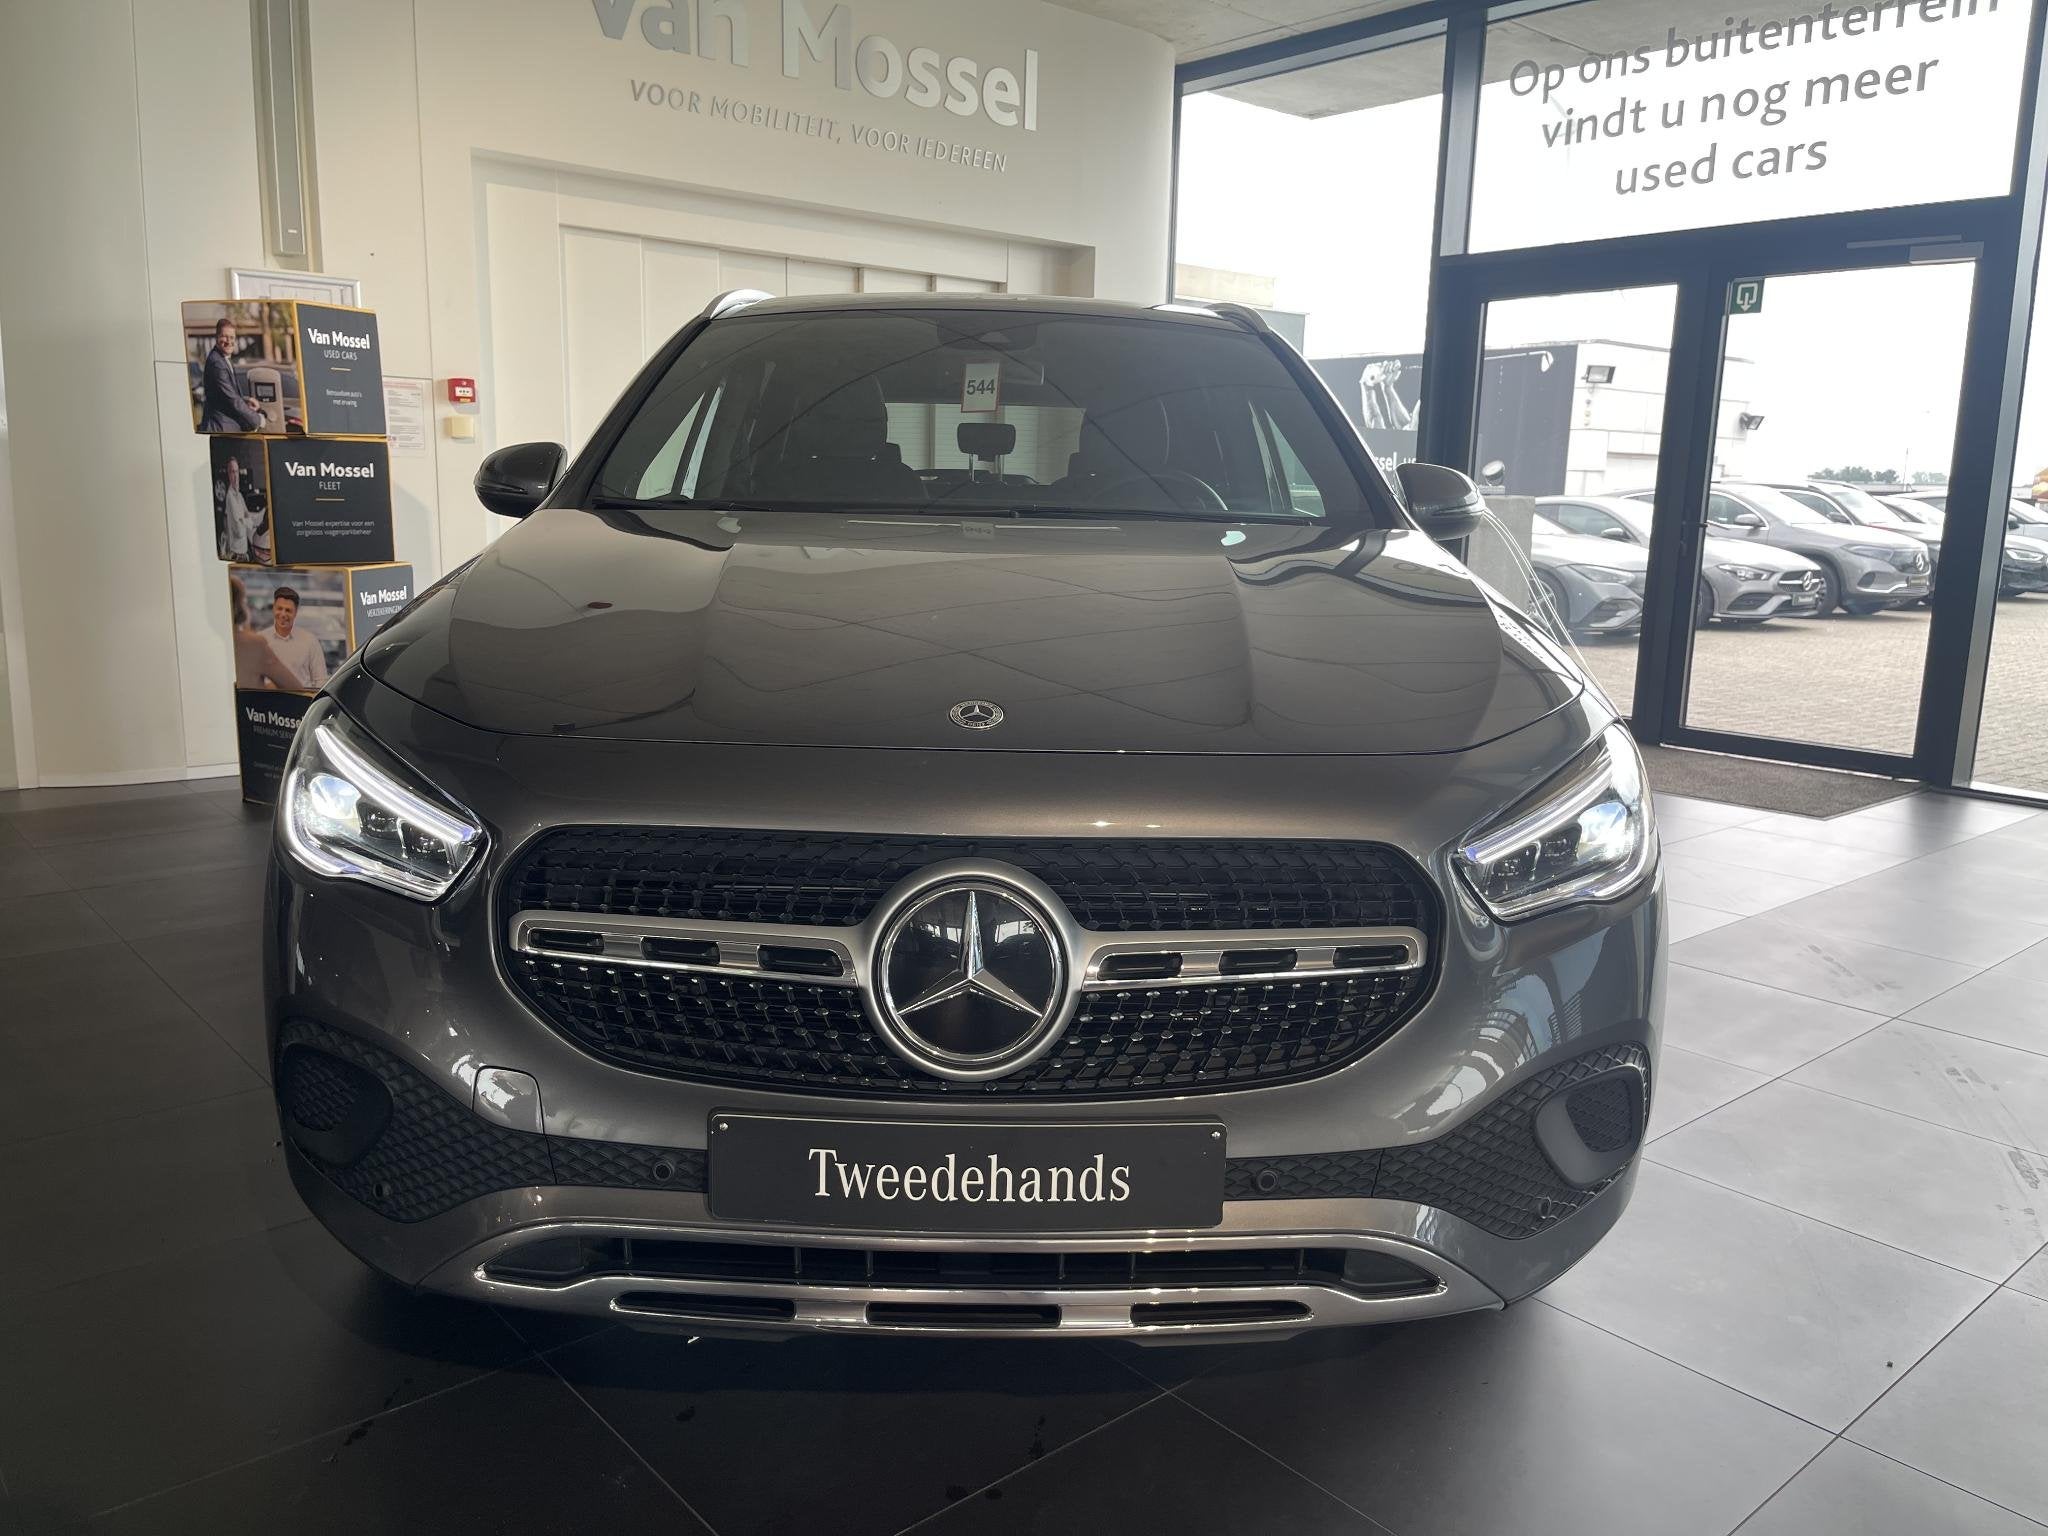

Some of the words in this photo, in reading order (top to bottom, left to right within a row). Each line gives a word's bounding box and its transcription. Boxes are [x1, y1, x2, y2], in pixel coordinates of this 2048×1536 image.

[782, 0, 1038, 131] Mossel
[1508, 60, 1564, 104] Op
[1578, 44, 1650, 84] ons
[1541, 96, 1647, 148] vindt
[1661, 97, 1685, 128] u
[1700, 80, 1790, 127] nog
[1804, 57, 1940, 108] meer
[630, 79, 701, 114] VOOR
[710, 95, 841, 144] MOBILITEIT,
[850, 122, 910, 154] VOOR
[915, 137, 1007, 173] IEDEREEN
[1616, 142, 1717, 195] used
[1731, 140, 1828, 185] cars
[307, 327, 331, 345] Van
[331, 330, 371, 350] Mossel
[323, 349, 340, 359] USED
[341, 350, 358, 361] CARS
[966, 379, 996, 396] 544
[284, 461, 317, 477] Van
[320, 462, 375, 478] Mossel
[318, 481, 341, 491] FLEET
[360, 591, 377, 606] Van
[378, 585, 407, 604] Mossel
[245, 706, 266, 723] Van
[268, 711, 304, 729] Mosse
[808, 1148, 1131, 1203] Tweedehands
